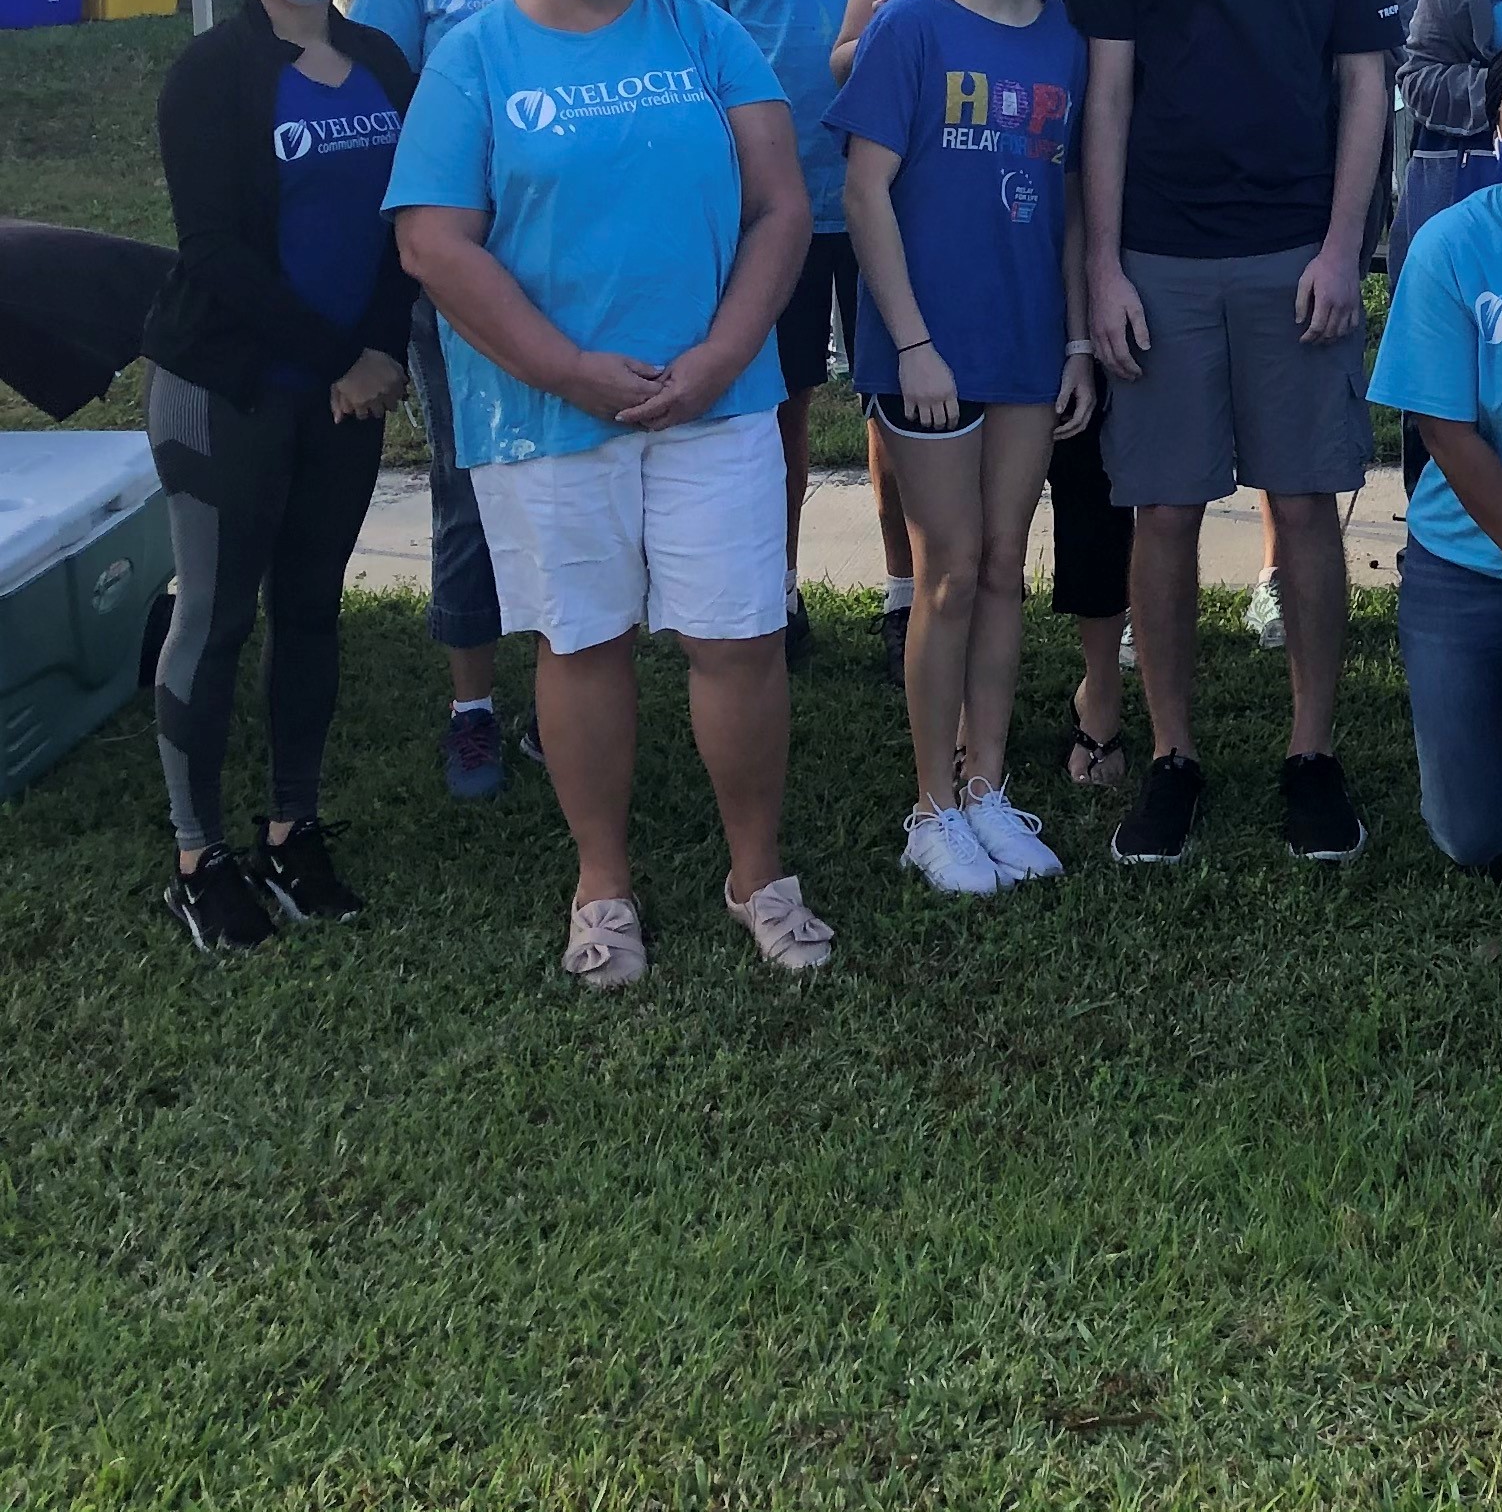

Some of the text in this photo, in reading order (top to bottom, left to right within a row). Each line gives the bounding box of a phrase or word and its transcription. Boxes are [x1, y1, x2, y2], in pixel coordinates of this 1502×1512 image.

[555, 67, 697, 106] VELOCIT
[559, 100, 637, 120] community
[641, 90, 679, 107] credit
[317, 135, 369, 153] community
[942, 127, 1001, 152] RELAY
